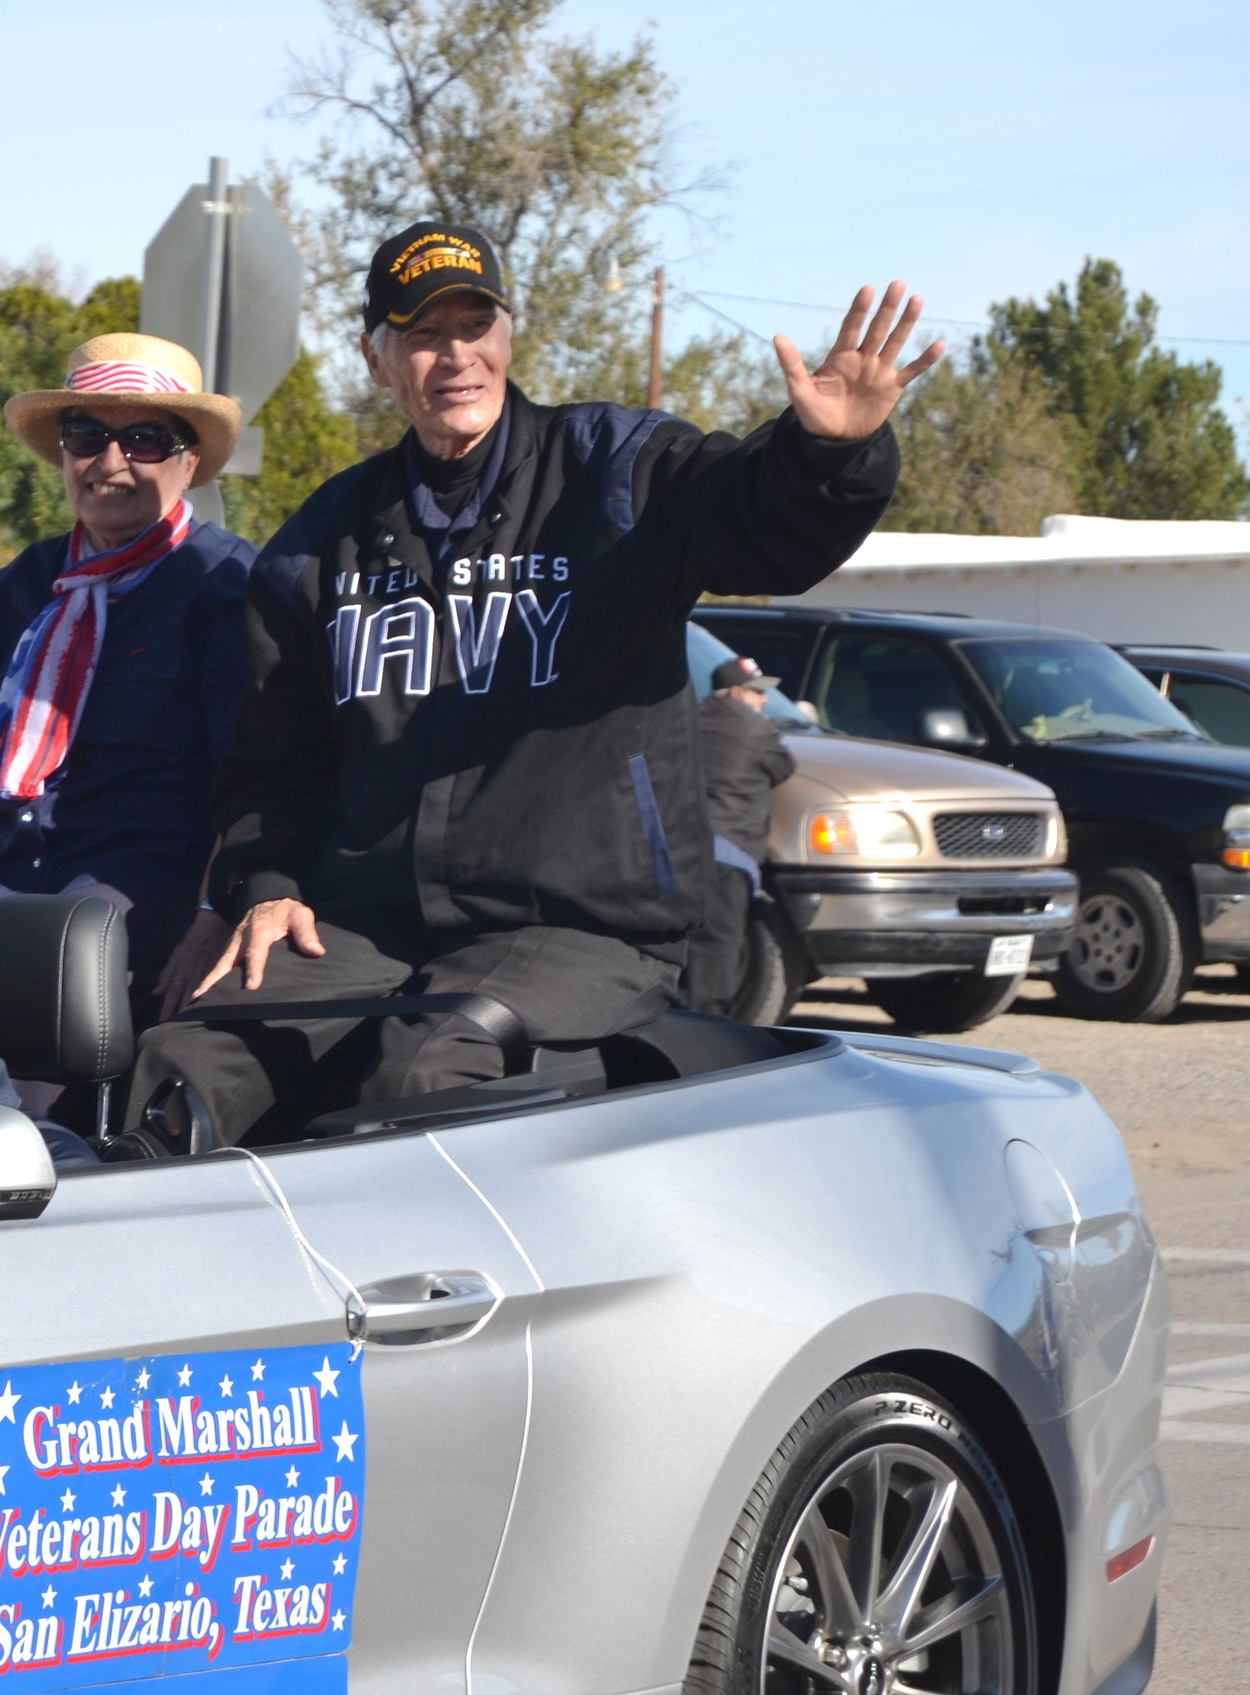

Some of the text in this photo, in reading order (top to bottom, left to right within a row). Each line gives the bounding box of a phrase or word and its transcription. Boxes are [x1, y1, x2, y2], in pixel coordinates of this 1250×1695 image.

[390, 233, 481, 272] VIETNAM WAR
[397, 255, 483, 285] VETERAN
[23, 1386, 319, 1472] Grand Marshall
[874, 1400, 953, 1431] P ZERO
[149, 1491, 226, 1567] Day
[231, 1476, 354, 1546] Parade
[67, 1582, 221, 1656] Elizario,
[233, 1574, 327, 1635] Texas
